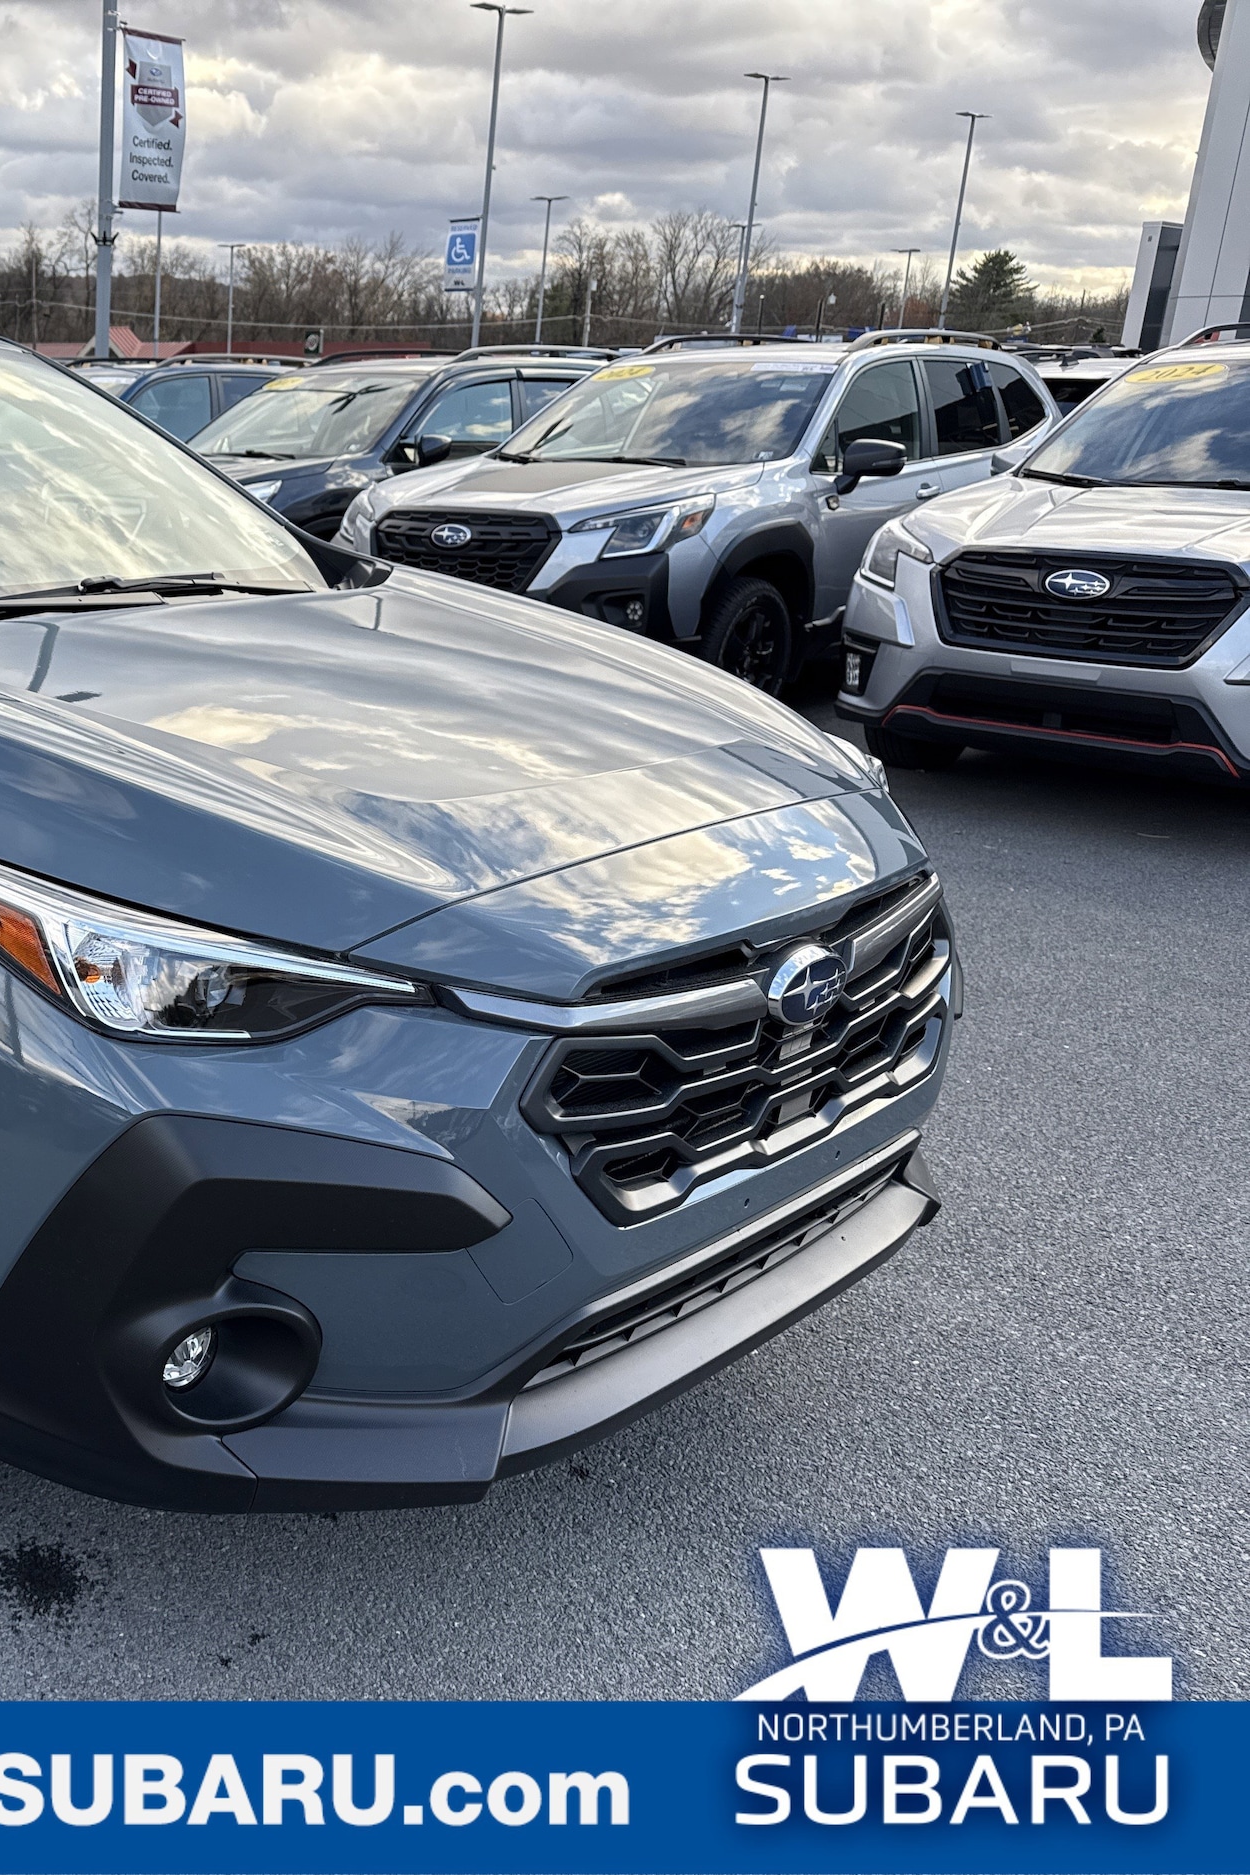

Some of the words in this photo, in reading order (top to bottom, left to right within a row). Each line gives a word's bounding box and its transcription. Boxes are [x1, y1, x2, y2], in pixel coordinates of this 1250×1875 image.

[134, 94, 175, 106] PRE-OWNED
[137, 87, 172, 98] CERTIFIED
[132, 135, 173, 151] Certified.
[129, 152, 174, 168] Inspected.
[131, 169, 171, 184] Covered.
